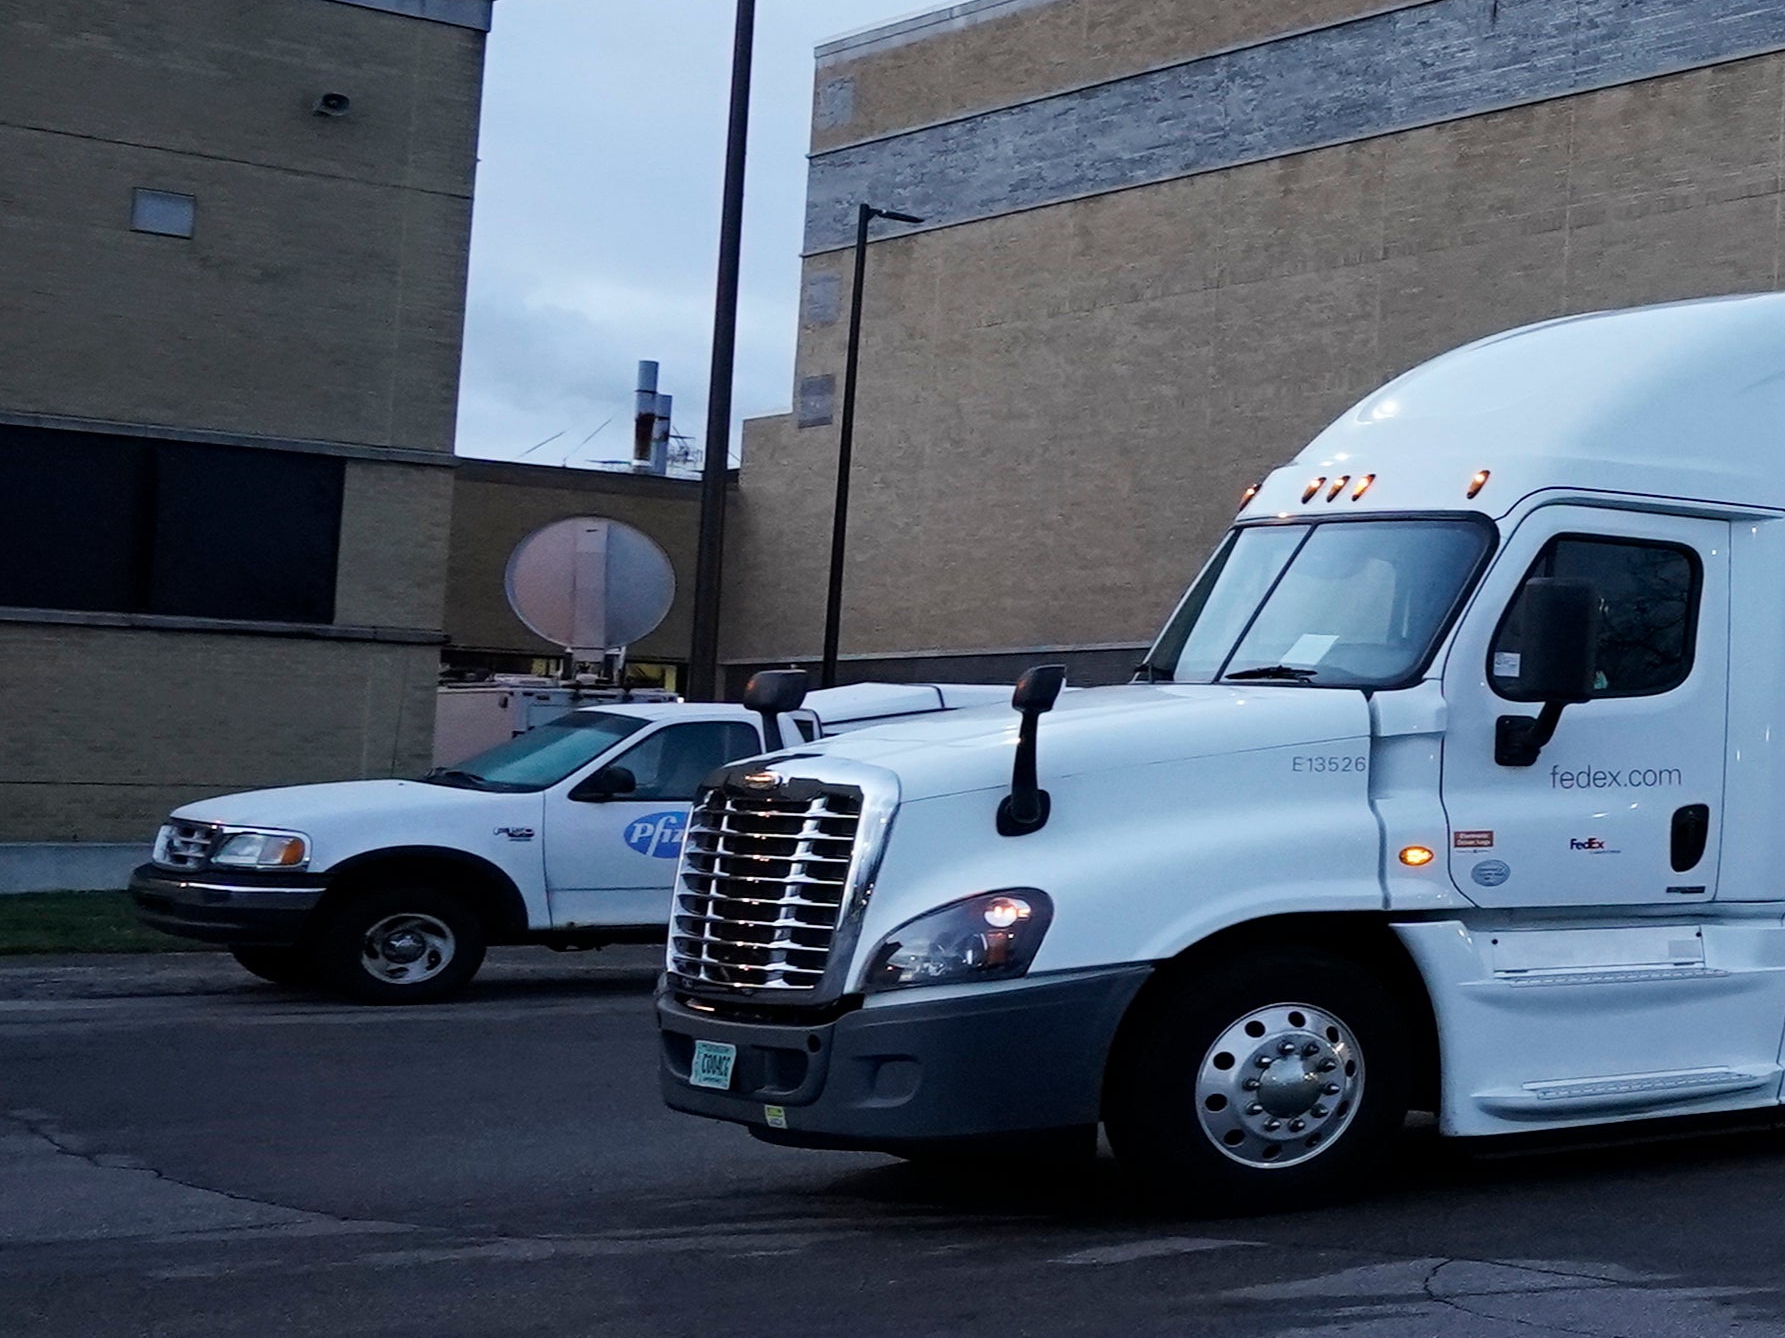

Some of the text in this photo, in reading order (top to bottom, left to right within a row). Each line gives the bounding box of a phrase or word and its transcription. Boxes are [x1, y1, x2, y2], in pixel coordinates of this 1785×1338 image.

[1292, 757, 1367, 773] E13526
[1550, 765, 1682, 789] fedex.com
[1570, 837, 1605, 850] FedEx
